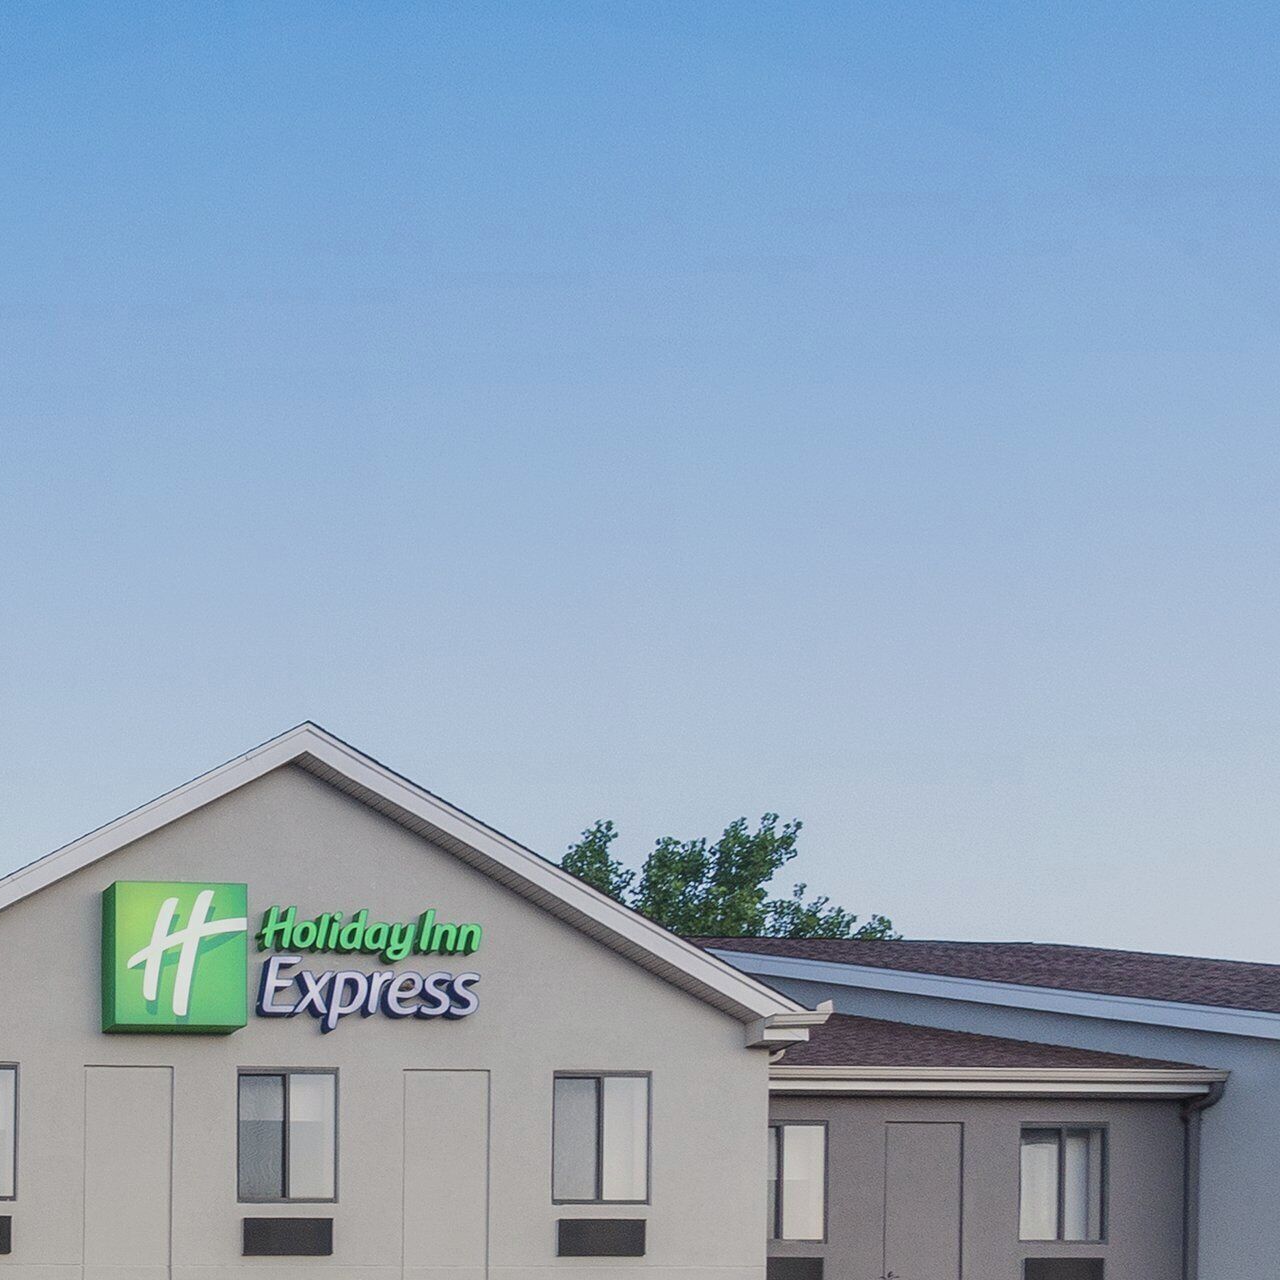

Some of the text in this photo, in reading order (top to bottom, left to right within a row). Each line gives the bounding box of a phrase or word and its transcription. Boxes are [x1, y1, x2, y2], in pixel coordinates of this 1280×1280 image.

[127, 889, 247, 1016] H
[258, 905, 483, 962] Holiday Inn
[258, 955, 481, 1032] Express
